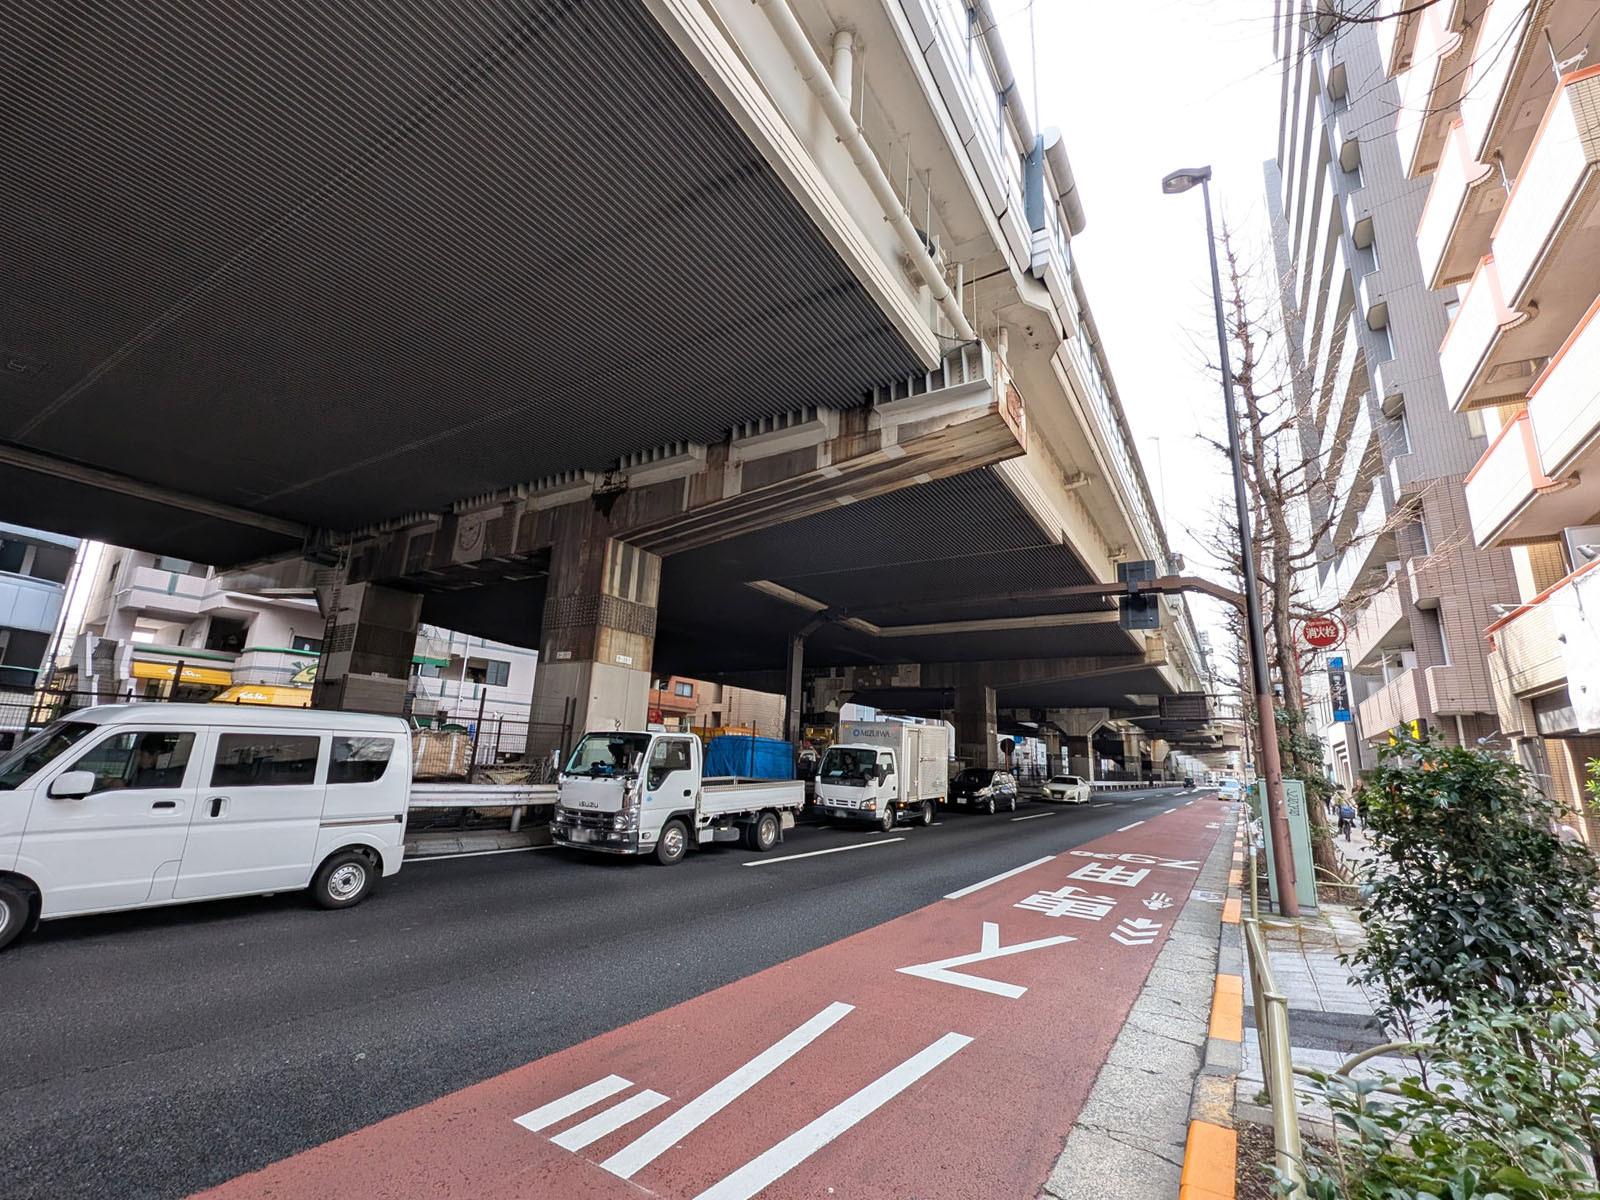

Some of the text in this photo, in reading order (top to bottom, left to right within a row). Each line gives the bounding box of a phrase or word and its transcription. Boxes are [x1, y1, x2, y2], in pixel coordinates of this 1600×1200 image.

[1305, 625, 1337, 639] 消火栓
[578, 800, 599, 809] ISUZU
